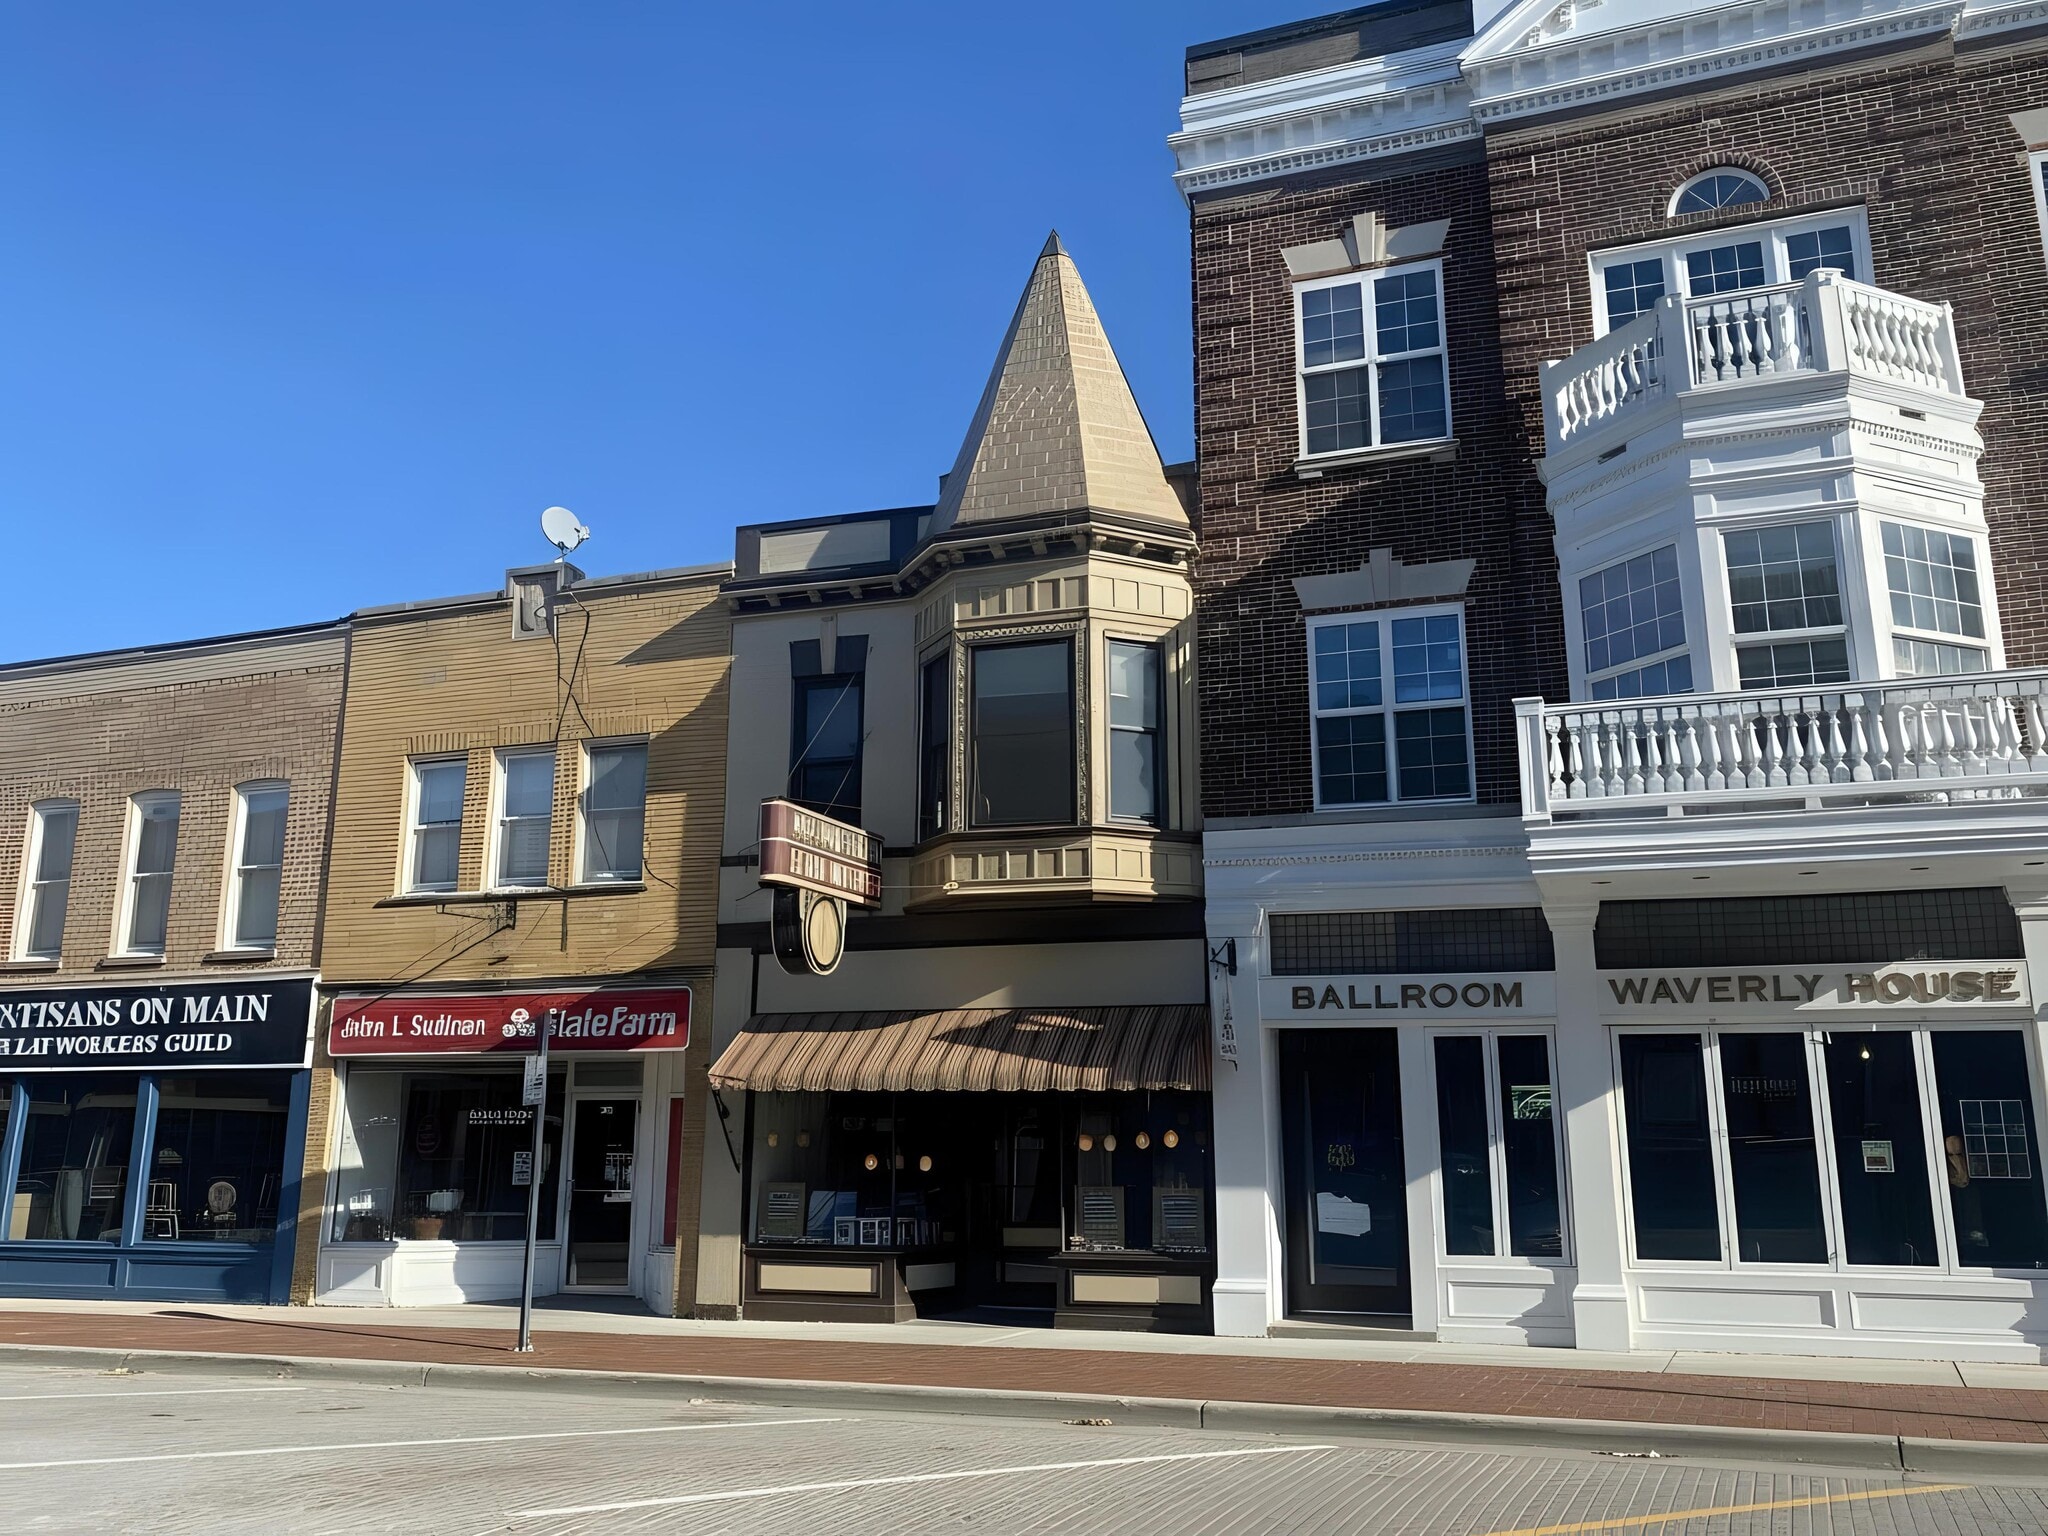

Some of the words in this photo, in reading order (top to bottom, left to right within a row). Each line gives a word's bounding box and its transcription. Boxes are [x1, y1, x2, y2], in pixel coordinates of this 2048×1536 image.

[1292, 982, 1523, 1009] BALLROOM
[1608, 974, 1824, 1005] WAVERLY
[1837, 967, 2021, 1005] HOUSE
[130, 998, 175, 1026] ON
[180, 994, 273, 1024] MAIN
[392, 1015, 403, 1037] L
[164, 1033, 232, 1052] GUILD
